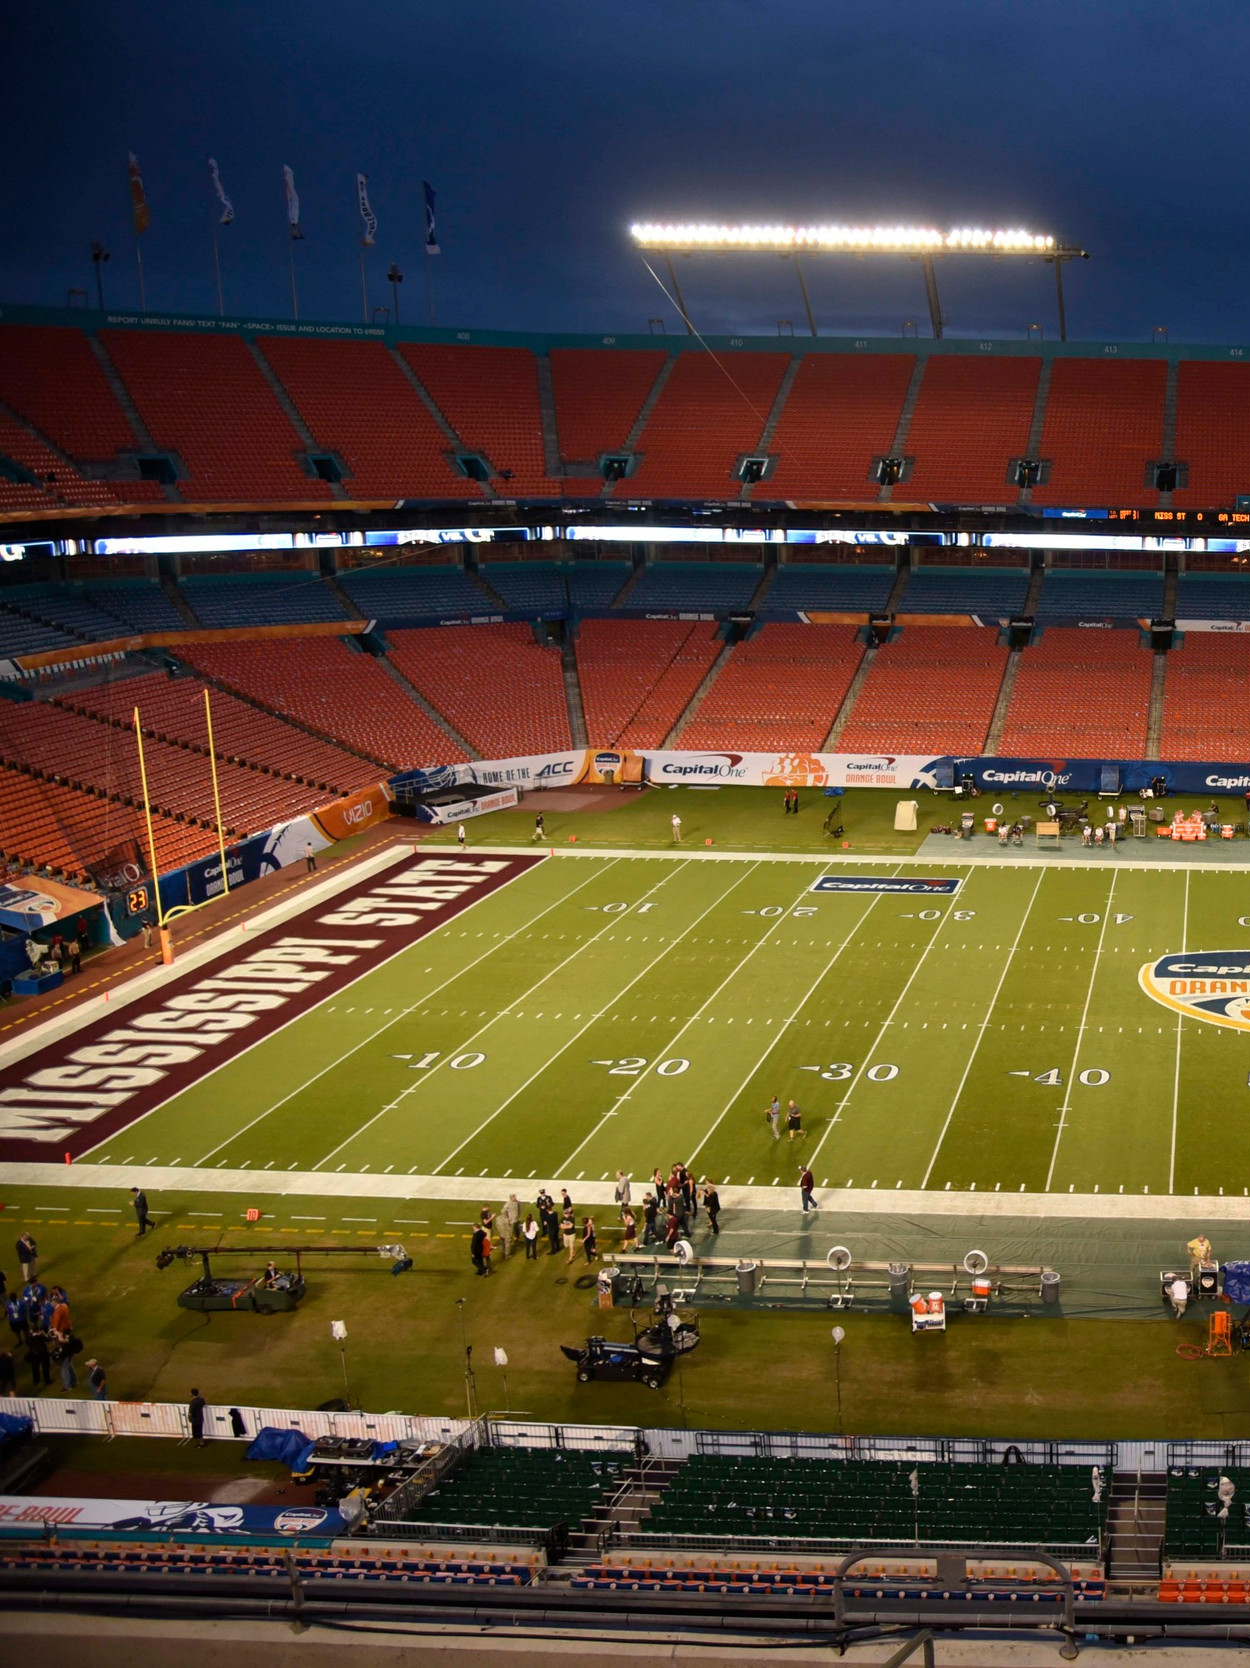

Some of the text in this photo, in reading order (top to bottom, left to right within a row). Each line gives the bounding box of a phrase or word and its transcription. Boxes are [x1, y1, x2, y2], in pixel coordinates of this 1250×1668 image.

[107, 316, 139, 324] REPORT
[141, 317, 171, 326] UNRULY
[173, 318, 195, 327] FANS!
[197, 319, 215, 328] TEXT
[219, 320, 240, 329] "FAN"
[243, 322, 274, 331] <SPACE>
[276, 324, 296, 332] ISSUE
[298, 325, 314, 333] AND
[316, 326, 351, 335] LOCATION
[353, 327, 362, 335] TO
[730, 339, 743, 347] 410
[854, 340, 867, 348] 411
[1104, 345, 1118, 353] 413
[1230, 348, 1243, 356] 414
[1177, 512, 1186, 520] ST
[1197, 513, 1203, 521] 0
[1218, 513, 1228, 521] GA
[1232, 513, 1250, 522] TECH
[482, 768, 531, 785] HOME OF THE
[538, 761, 576, 777] ACC
[845, 774, 897, 785] ORANGE BOWL
[343, 800, 373, 825] VIZIO
[129, 890, 146, 911] 23
[314, 858, 514, 927] STATE
[595, 900, 657, 916] 10
[751, 904, 820, 919] 20
[910, 908, 977, 923] 30
[1075, 911, 1135, 926] 40
[0, 936, 386, 1143] MISSISSIPPI
[407, 1050, 488, 1070] 10
[606, 1056, 692, 1077] 20
[820, 1062, 901, 1083] 30
[1034, 1066, 1112, 1086] 40
[14, 1505, 85, 1523] BOWL
